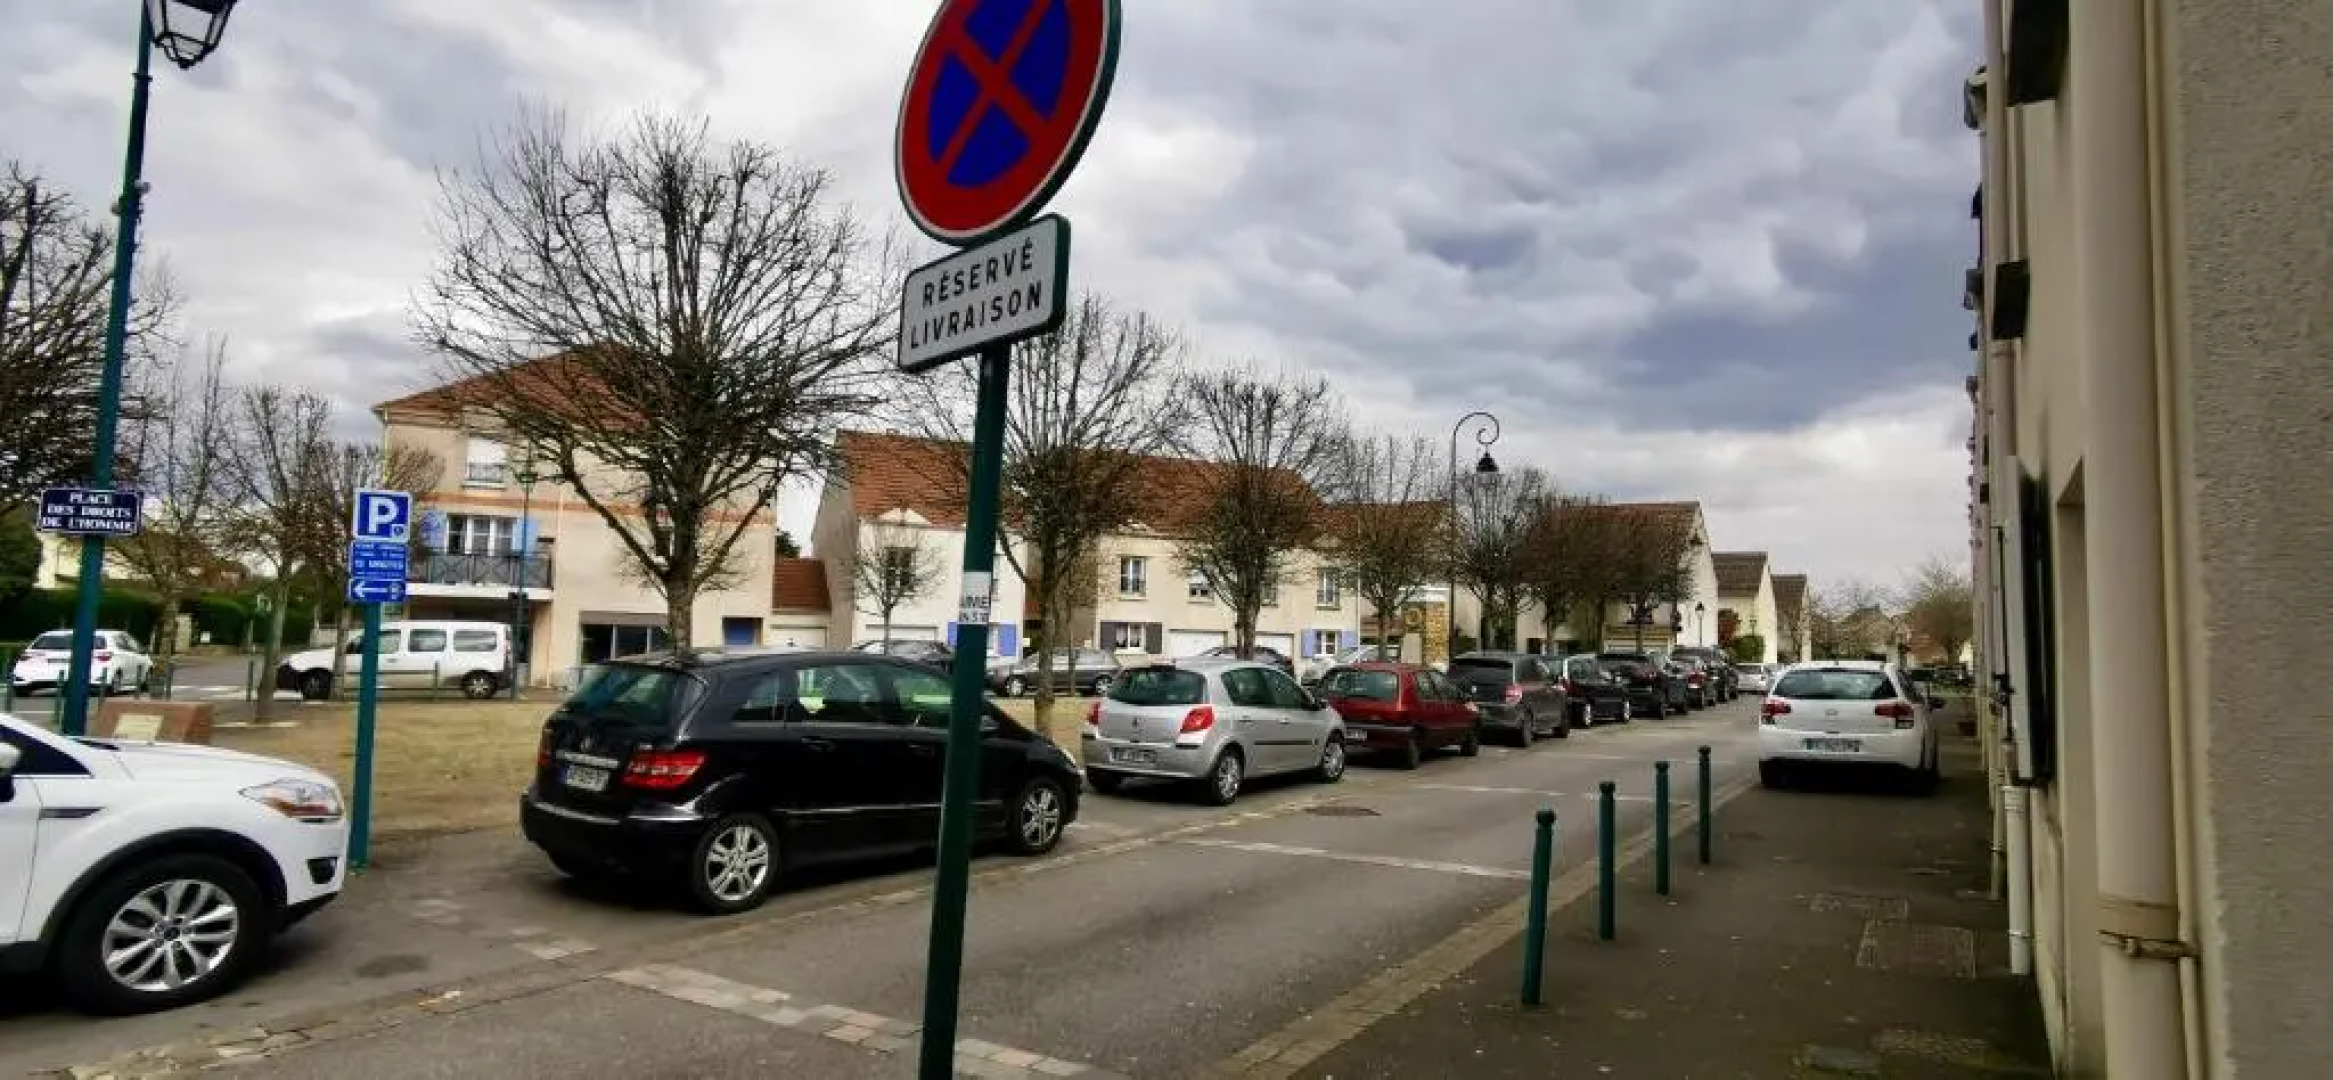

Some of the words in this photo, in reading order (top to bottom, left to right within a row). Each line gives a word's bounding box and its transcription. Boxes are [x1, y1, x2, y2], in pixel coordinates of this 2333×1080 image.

[922, 236, 1034, 310] RÉSERVÉ
[910, 280, 1042, 349] LIVRAISON
[47, 503, 75, 515] DES
[81, 505, 131, 517] DROITS
[70, 493, 112, 504] PLACE
[42, 516, 62, 527] DE
[68, 517, 134, 530] L'HOMME
[368, 496, 398, 534] P
